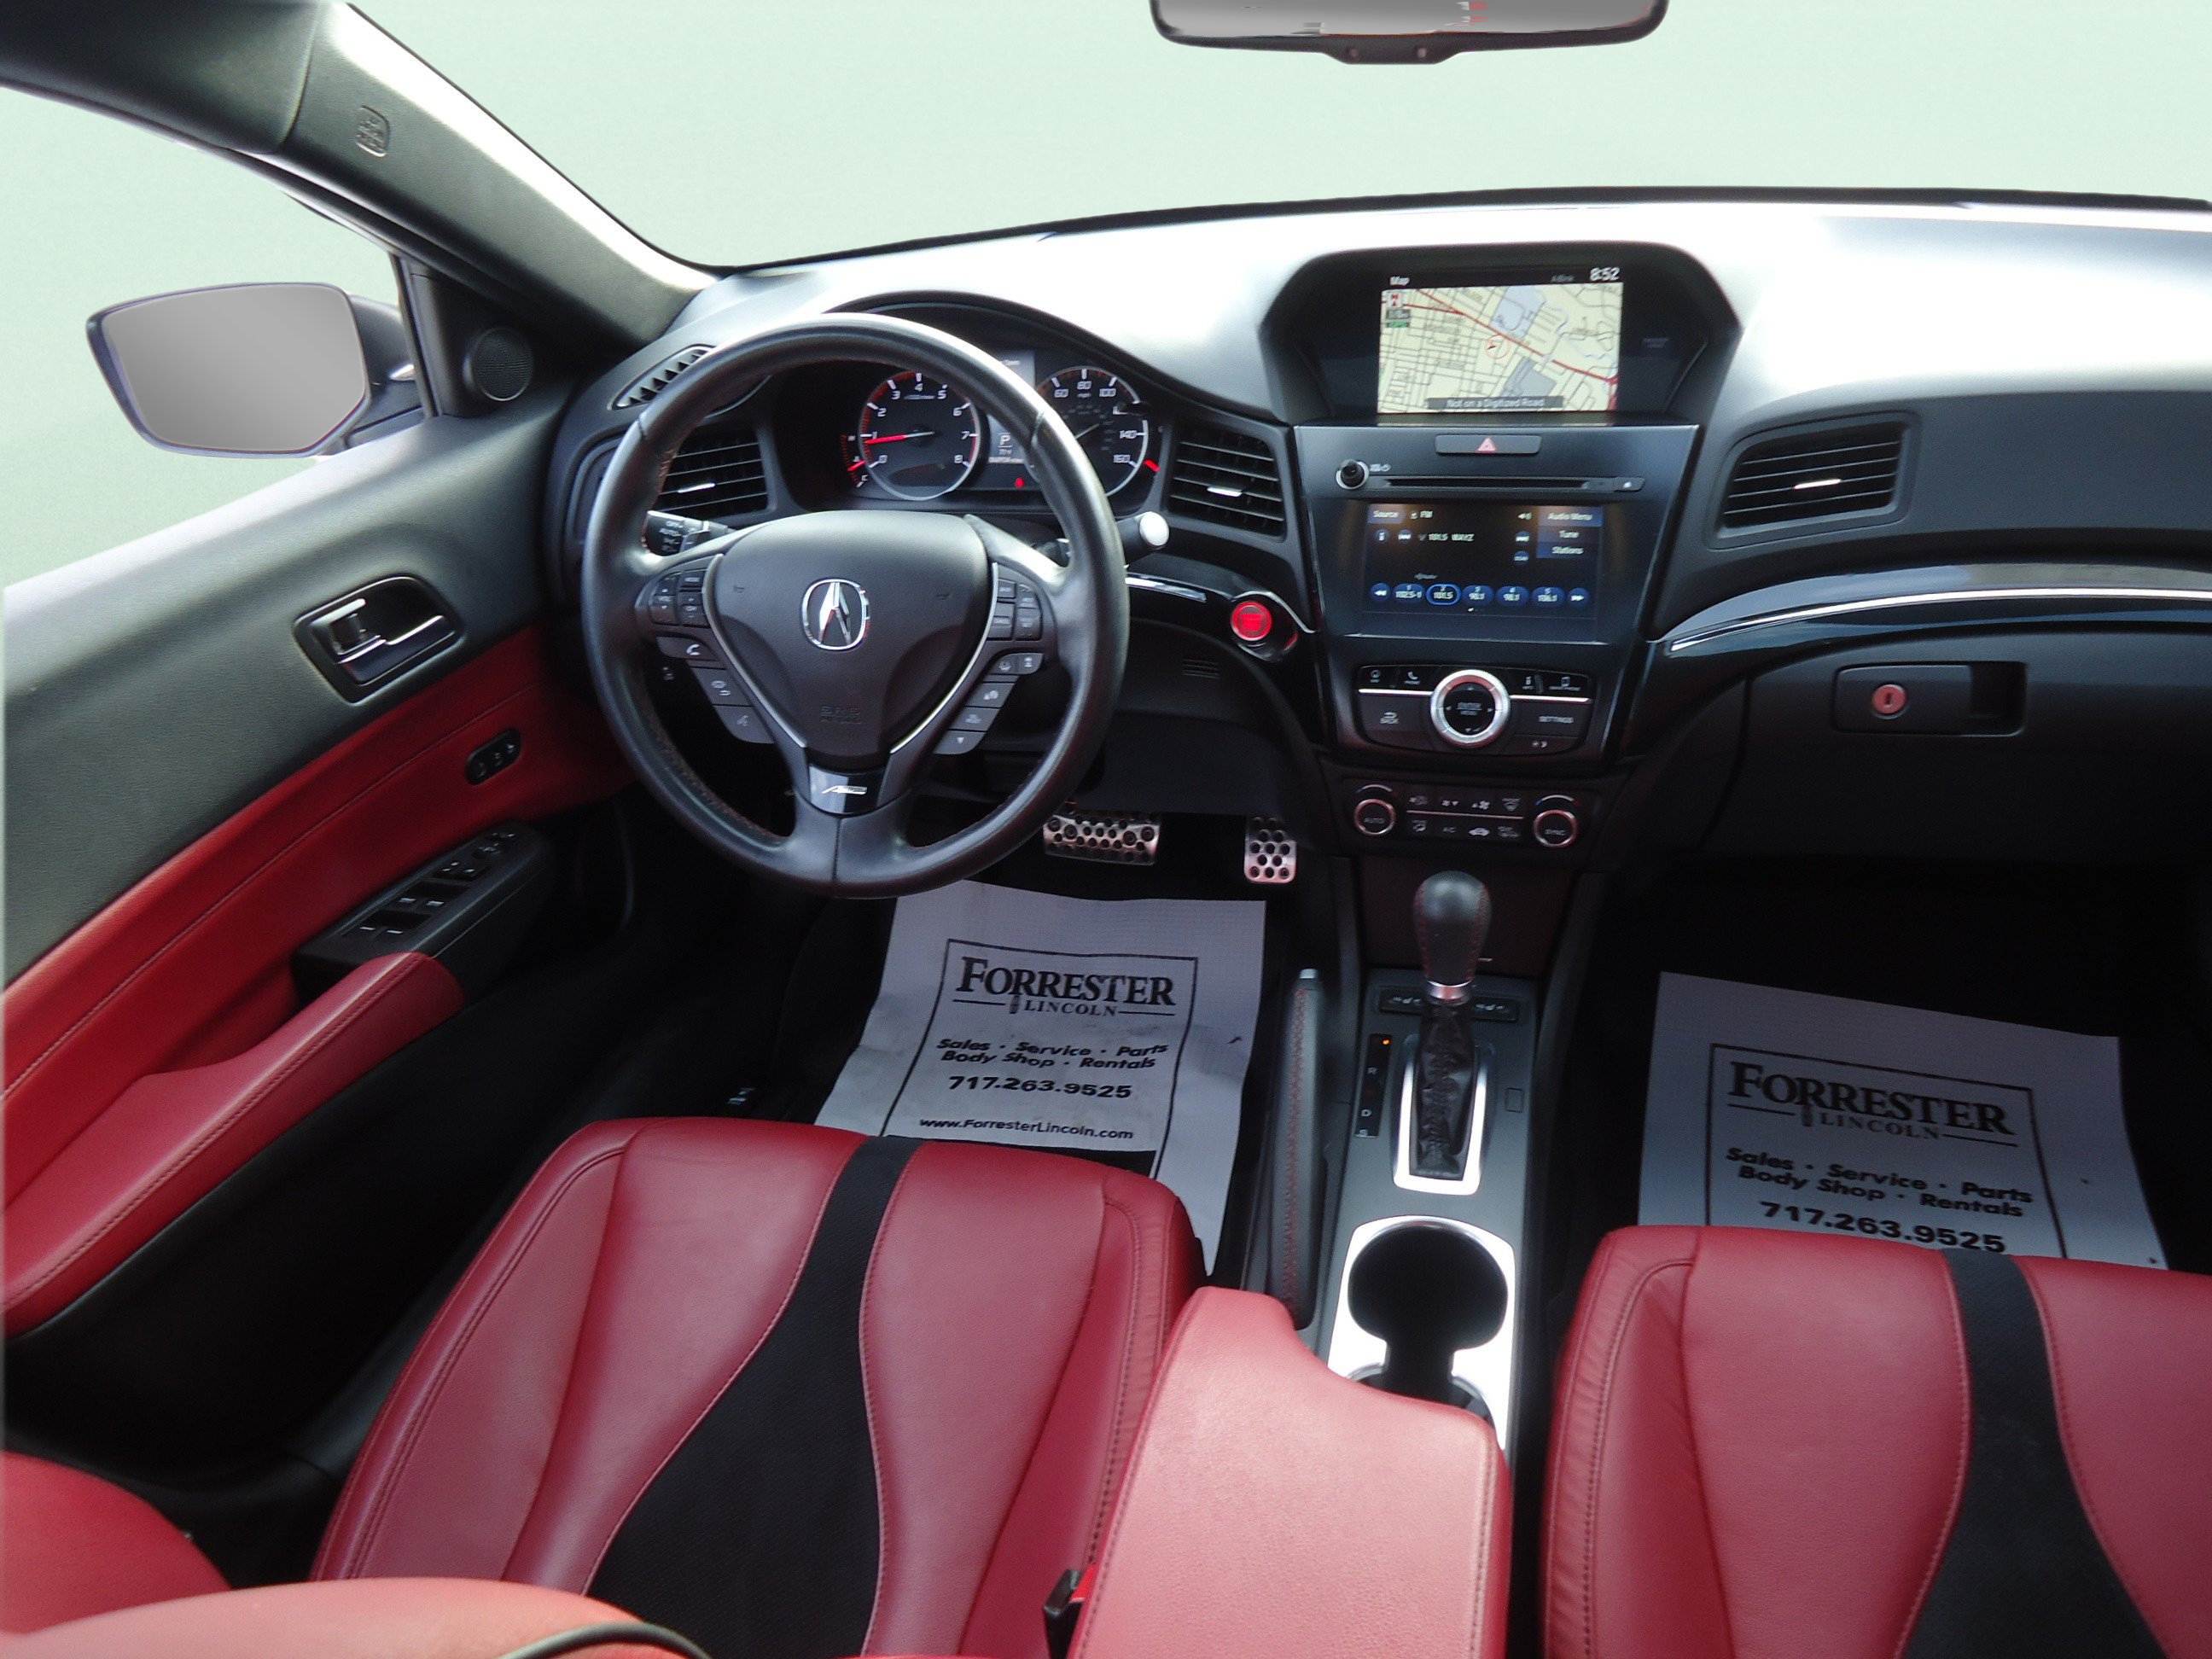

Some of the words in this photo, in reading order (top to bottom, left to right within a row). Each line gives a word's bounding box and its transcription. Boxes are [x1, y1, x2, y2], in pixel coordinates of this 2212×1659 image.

[891, 390, 901, 400] 3
[914, 383, 923, 392] 4
[937, 389, 947, 399] 5
[877, 407, 887, 417] 2
[952, 407, 963, 416] 6
[961, 430, 970, 439] 7
[999, 434, 1011, 446] P
[953, 454, 963, 463] 8
[956, 956, 1176, 1007] FORRESTER
[1024, 1001, 1117, 1016] LINCOLN
[937, 1038, 991, 1051] Sales
[1016, 1041, 1091, 1057] Service
[1116, 1042, 1169, 1058] Parts
[941, 1051, 997, 1065] Body
[1002, 1052, 1055, 1068] Shop
[1079, 1057, 1156, 1070] Rentals
[948, 1075, 1132, 1099] 717.263.9525
[1727, 1060, 2017, 1137] FORRESTER
[919, 1118, 1133, 1140] www.ForresterLincoln.com
[1819, 1111, 1941, 1140] LINCOLN
[1726, 1147, 1796, 1171] Sales
[1827, 1162, 1929, 1190] Service
[1960, 1181, 2034, 1204] Parts
[1738, 1166, 1809, 1190] Body
[1817, 1178, 1886, 1202] Shop
[1919, 1194, 2024, 1218] Rentals
[1760, 1200, 2006, 1254] 717.263.9525
